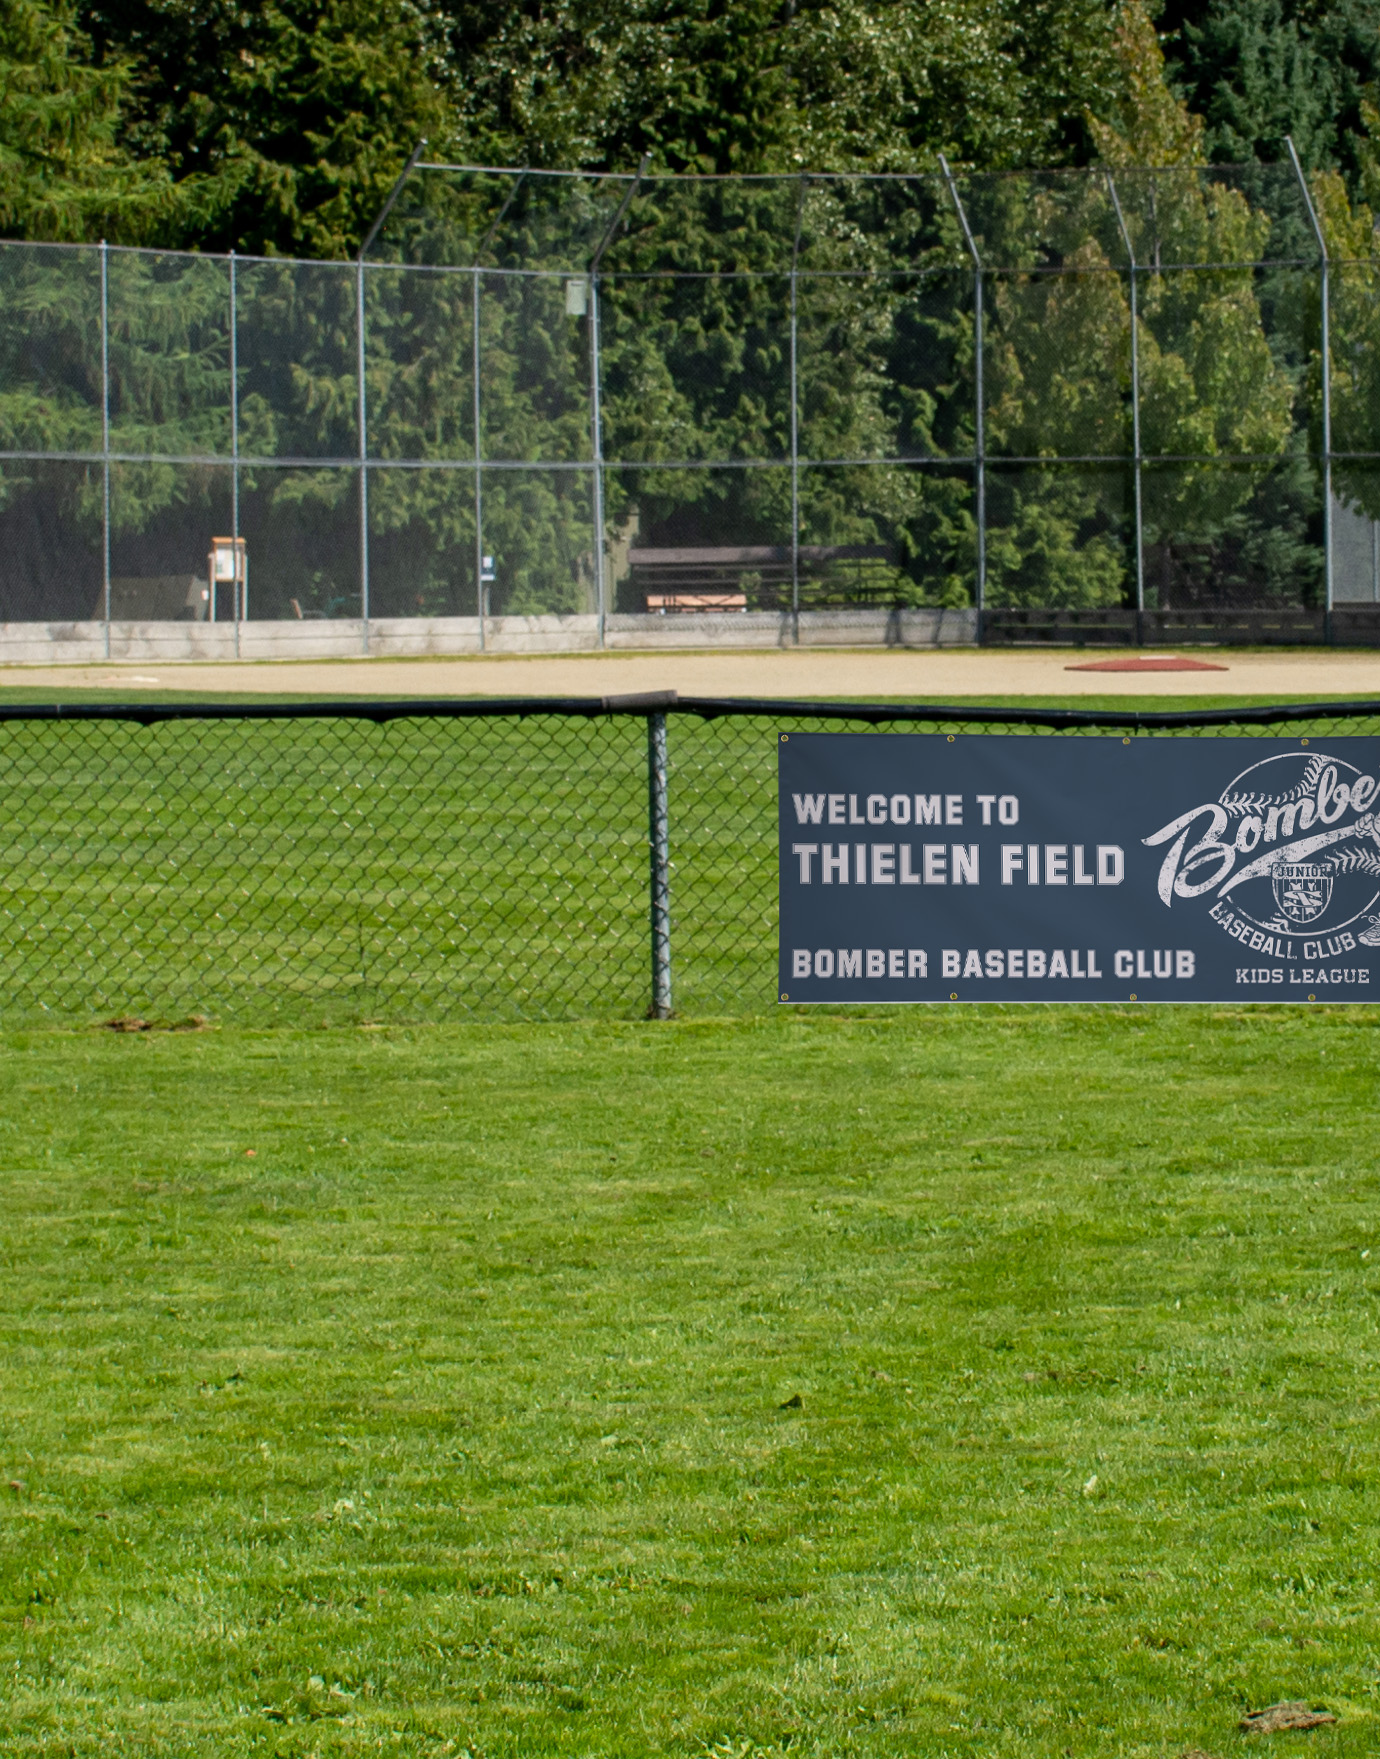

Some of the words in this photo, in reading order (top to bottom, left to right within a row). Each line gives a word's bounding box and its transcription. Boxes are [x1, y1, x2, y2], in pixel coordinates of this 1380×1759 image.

[791, 793, 964, 826] WELCOME
[975, 794, 1020, 826] TO
[791, 842, 981, 885] THIELEN
[1000, 843, 1125, 886] FIELD
[1277, 866, 1328, 878] JUNIOR
[1303, 932, 1357, 960] CLUB
[791, 948, 928, 979] BOMBER
[941, 948, 1102, 979] BASEBALL
[1113, 949, 1196, 979] CLUB
[1235, 968, 1284, 984] KIDS
[1289, 968, 1370, 984] LEAGUE
